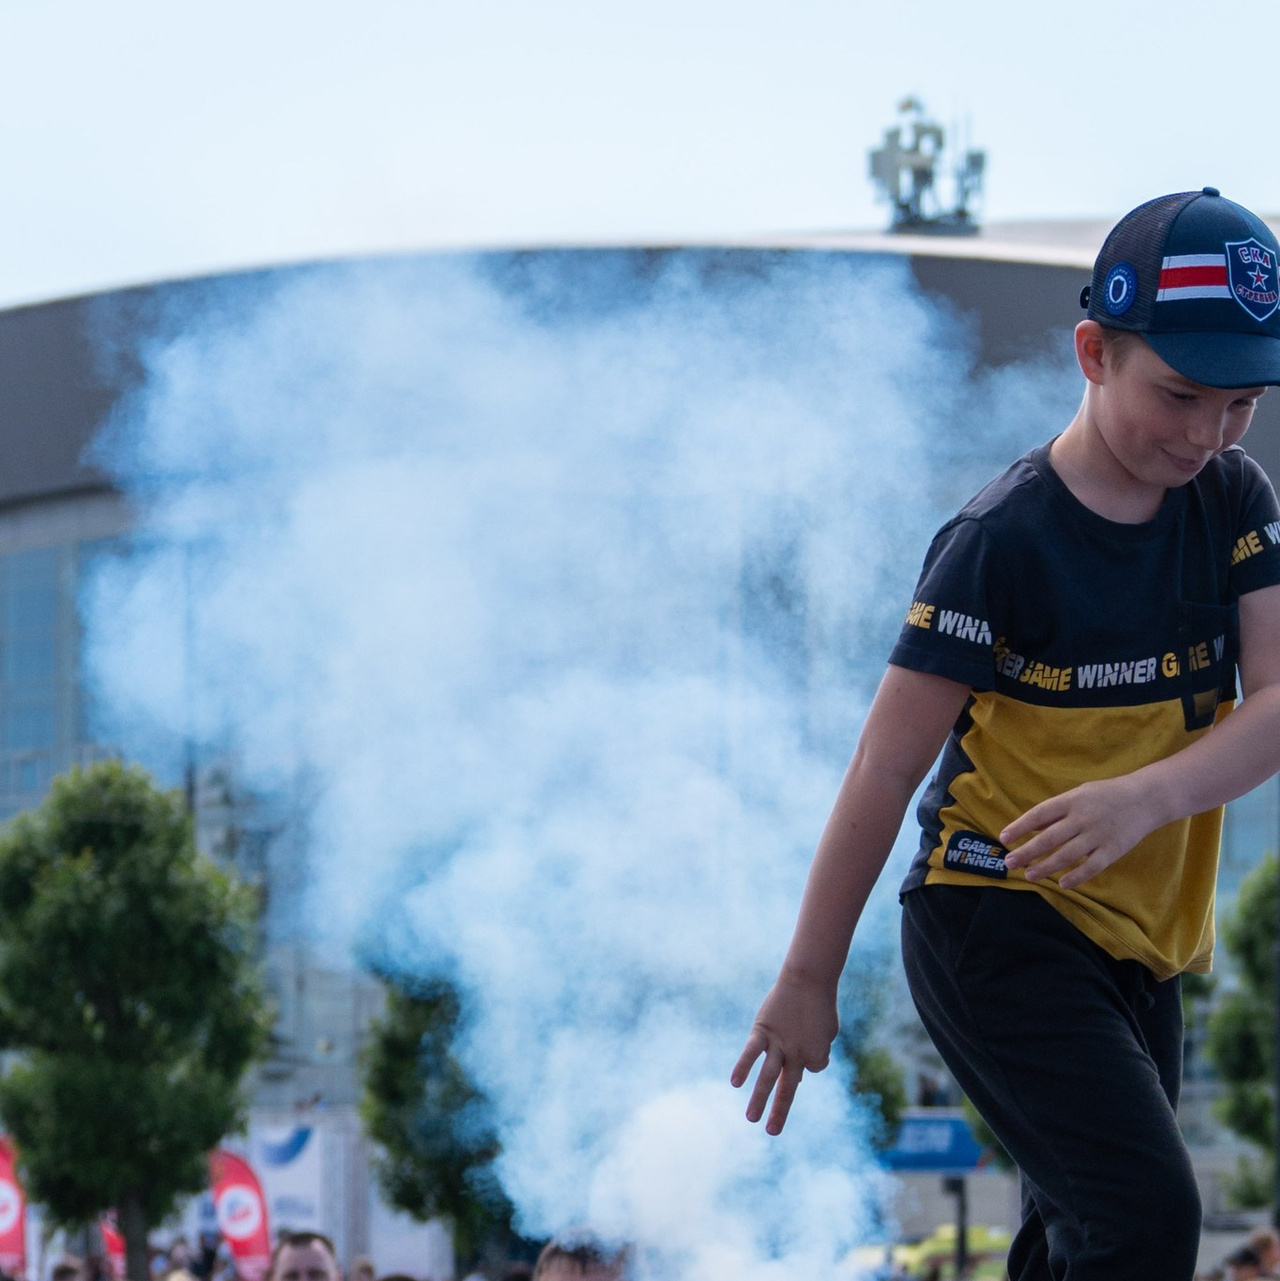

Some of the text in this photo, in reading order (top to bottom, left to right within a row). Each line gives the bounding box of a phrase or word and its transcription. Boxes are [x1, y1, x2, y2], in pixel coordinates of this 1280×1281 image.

[1077, 657, 1157, 689] WINNER
[957, 837, 1003, 857] GAME
[947, 849, 1006, 872] WINNER
